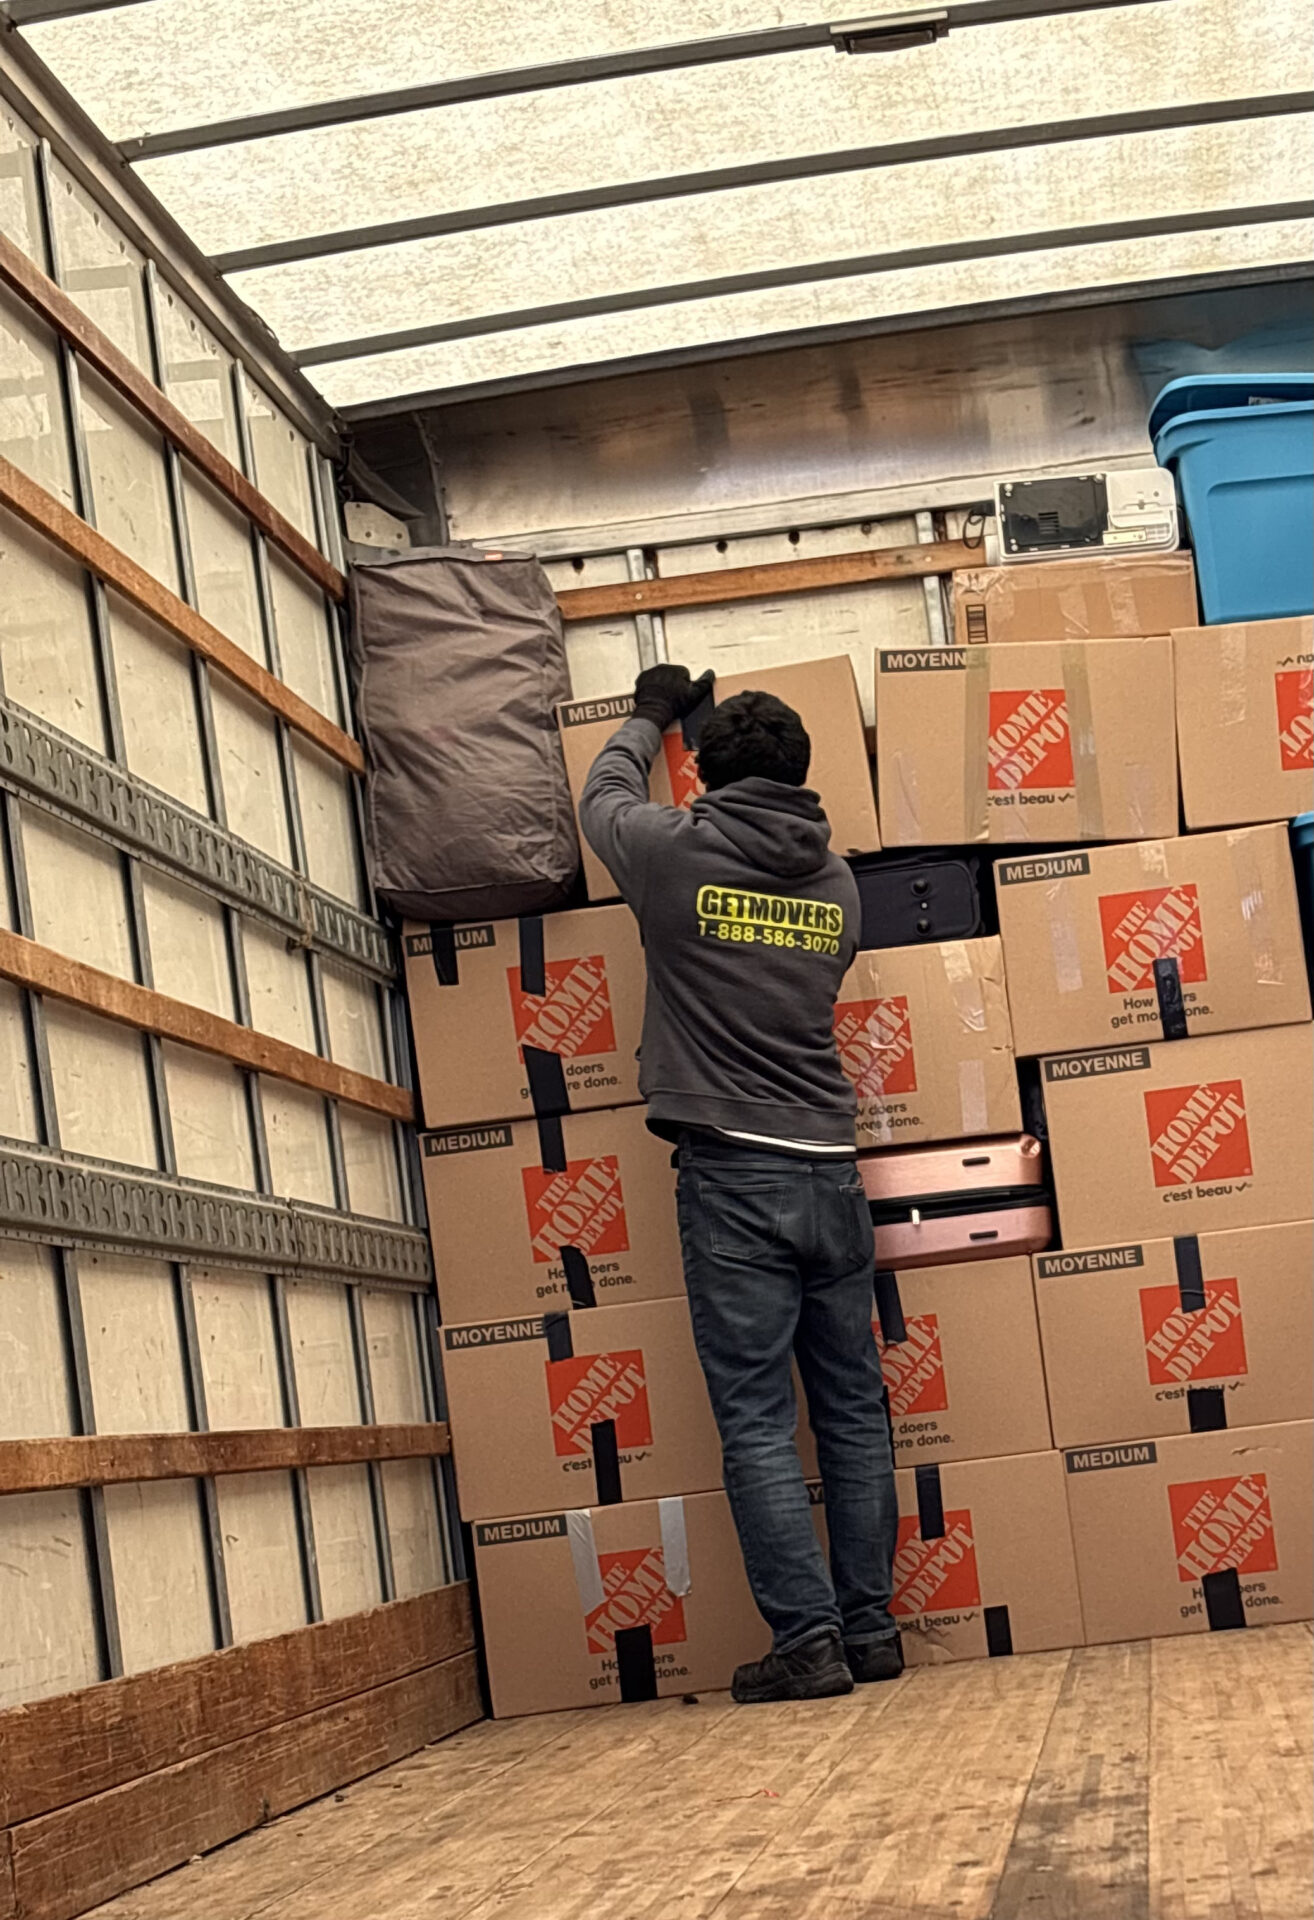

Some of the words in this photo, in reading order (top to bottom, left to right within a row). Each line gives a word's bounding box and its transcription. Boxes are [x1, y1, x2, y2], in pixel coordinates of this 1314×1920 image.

[887, 652, 968, 669] MOYENN
[987, 689, 1054, 768] HOME
[1018, 792, 1055, 805] beau
[1006, 858, 1083, 881] MEDIUM
[701, 889, 840, 932] GETMOVERS
[1111, 900, 1151, 943] THE
[412, 929, 488, 952] MIUM
[698, 920, 840, 955] 1-888-586-3070
[1107, 886, 1199, 991] HOME
[518, 957, 606, 1051] HOME
[1123, 997, 1154, 1010] How
[556, 991, 610, 1058] DEPOT
[833, 1012, 863, 1043] HE
[1110, 1013, 1134, 1028] get
[1184, 1005, 1214, 1017] one.
[838, 997, 911, 1080] OME
[566, 1063, 605, 1076] doers
[857, 1032, 912, 1097] DEPOT
[1052, 1052, 1144, 1077] MOYENNE
[868, 1103, 908, 1116] doers
[1151, 1084, 1222, 1165] HOME
[431, 1130, 506, 1152] MEDIUM
[1169, 1092, 1246, 1185] DEPOT
[535, 1172, 574, 1213] THE
[1162, 1188, 1193, 1203] c'est
[1197, 1184, 1233, 1198] beau
[531, 1158, 620, 1260] HOME
[570, 1191, 624, 1256] DEPOT
[547, 1268, 566, 1280] Ho
[590, 1262, 620, 1275] oers
[1045, 1250, 1137, 1274] MOYENNE
[536, 1283, 559, 1298] get
[452, 1321, 544, 1346] MOYENNE
[1164, 1290, 1241, 1382] DEPOT
[880, 1316, 939, 1393] OME
[551, 1353, 623, 1434] HOME
[889, 1350, 943, 1415] DEPOT
[1155, 1387, 1185, 1401] c'est
[899, 1421, 938, 1434] doers
[892, 1438, 914, 1450] ore
[562, 1458, 592, 1472] c'est
[1073, 1446, 1150, 1469] MEDIUM
[1181, 1489, 1221, 1531] THE
[484, 1519, 560, 1541] MEDIUM
[1177, 1474, 1269, 1578] HOME
[1216, 1510, 1272, 1572] DEPOT
[603, 1562, 631, 1594] HE
[898, 1522, 975, 1614] DEPOT
[924, 1615, 960, 1628] beau
[1180, 1602, 1203, 1617] get
[601, 1659, 620, 1671] Ho
[589, 1674, 612, 1690] get
